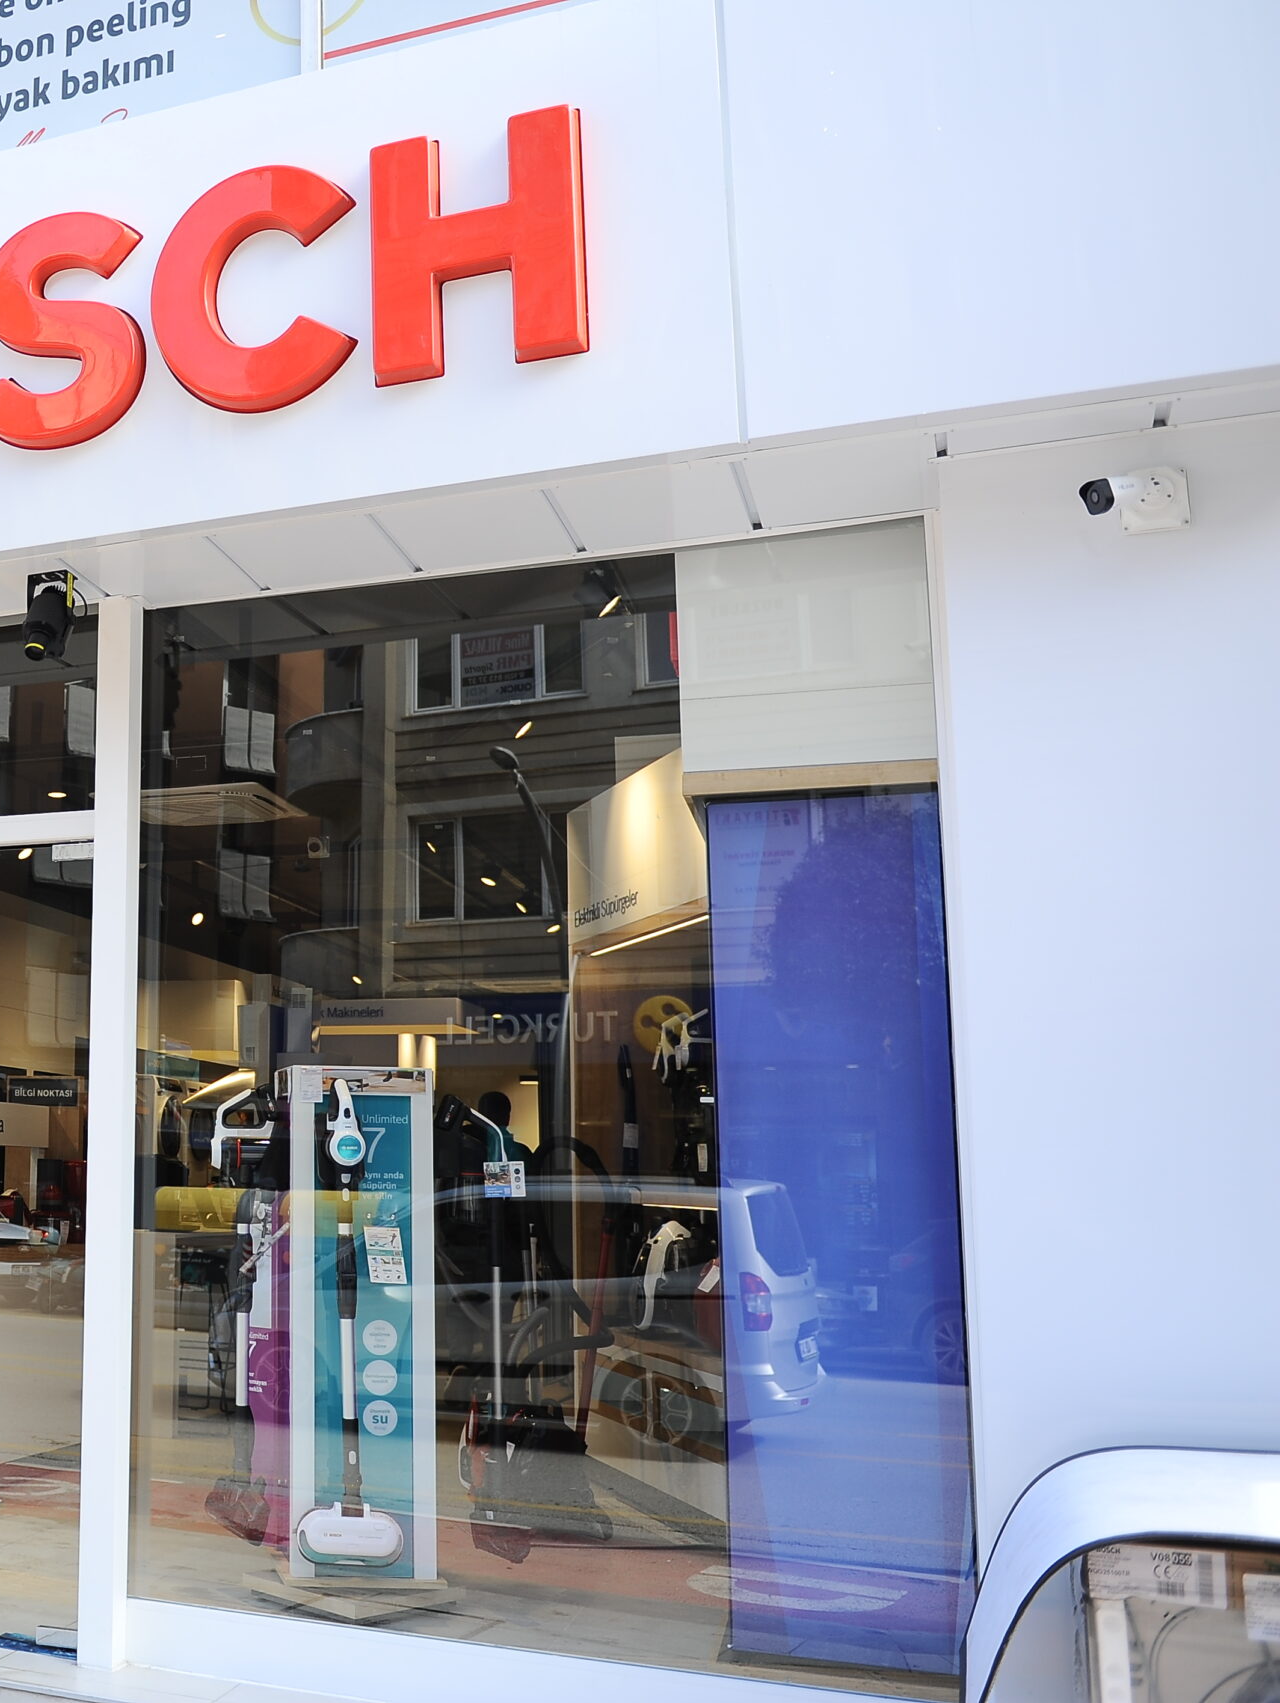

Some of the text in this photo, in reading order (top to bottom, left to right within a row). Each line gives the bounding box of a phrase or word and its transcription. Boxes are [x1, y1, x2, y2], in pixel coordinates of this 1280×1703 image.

[65, 0, 192, 57] peeling
[61, 49, 175, 100] bakımı
[601, 889, 638, 918] Süpürgeler
[327, 1006, 384, 1018] Makineleri
[14, 1087, 73, 1098] BİLGİ NOKTASI
[361, 1113, 409, 1124] Unlimited
[362, 1127, 386, 1163] 7
[383, 1171, 404, 1179] anda
[362, 1181, 397, 1191] süpürün
[372, 1415, 388, 1425] su
